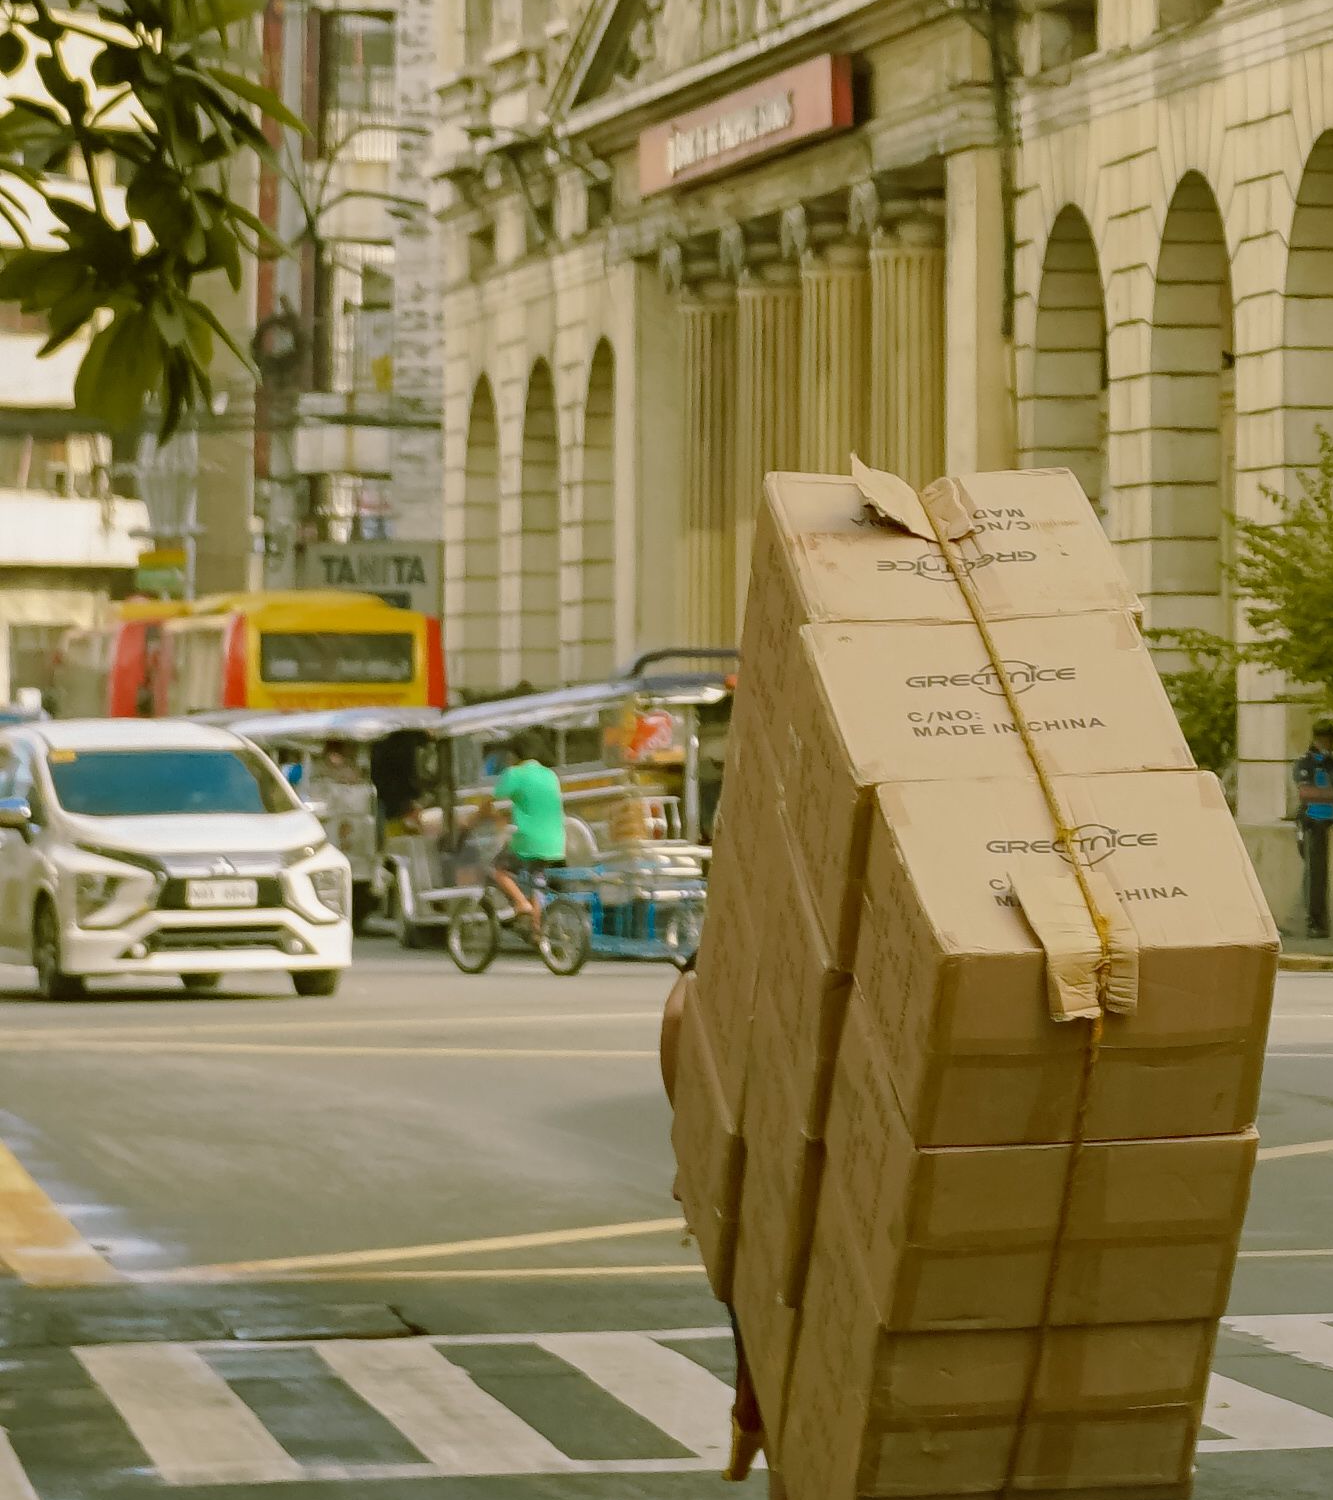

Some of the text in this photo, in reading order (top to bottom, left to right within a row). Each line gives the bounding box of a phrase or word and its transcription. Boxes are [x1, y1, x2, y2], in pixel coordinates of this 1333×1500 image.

[973, 508, 1025, 519] MAD
[906, 709, 982, 724] C/NO:
[911, 716, 1107, 737] MADE IN CHINA
[1115, 885, 1189, 903] HINA
